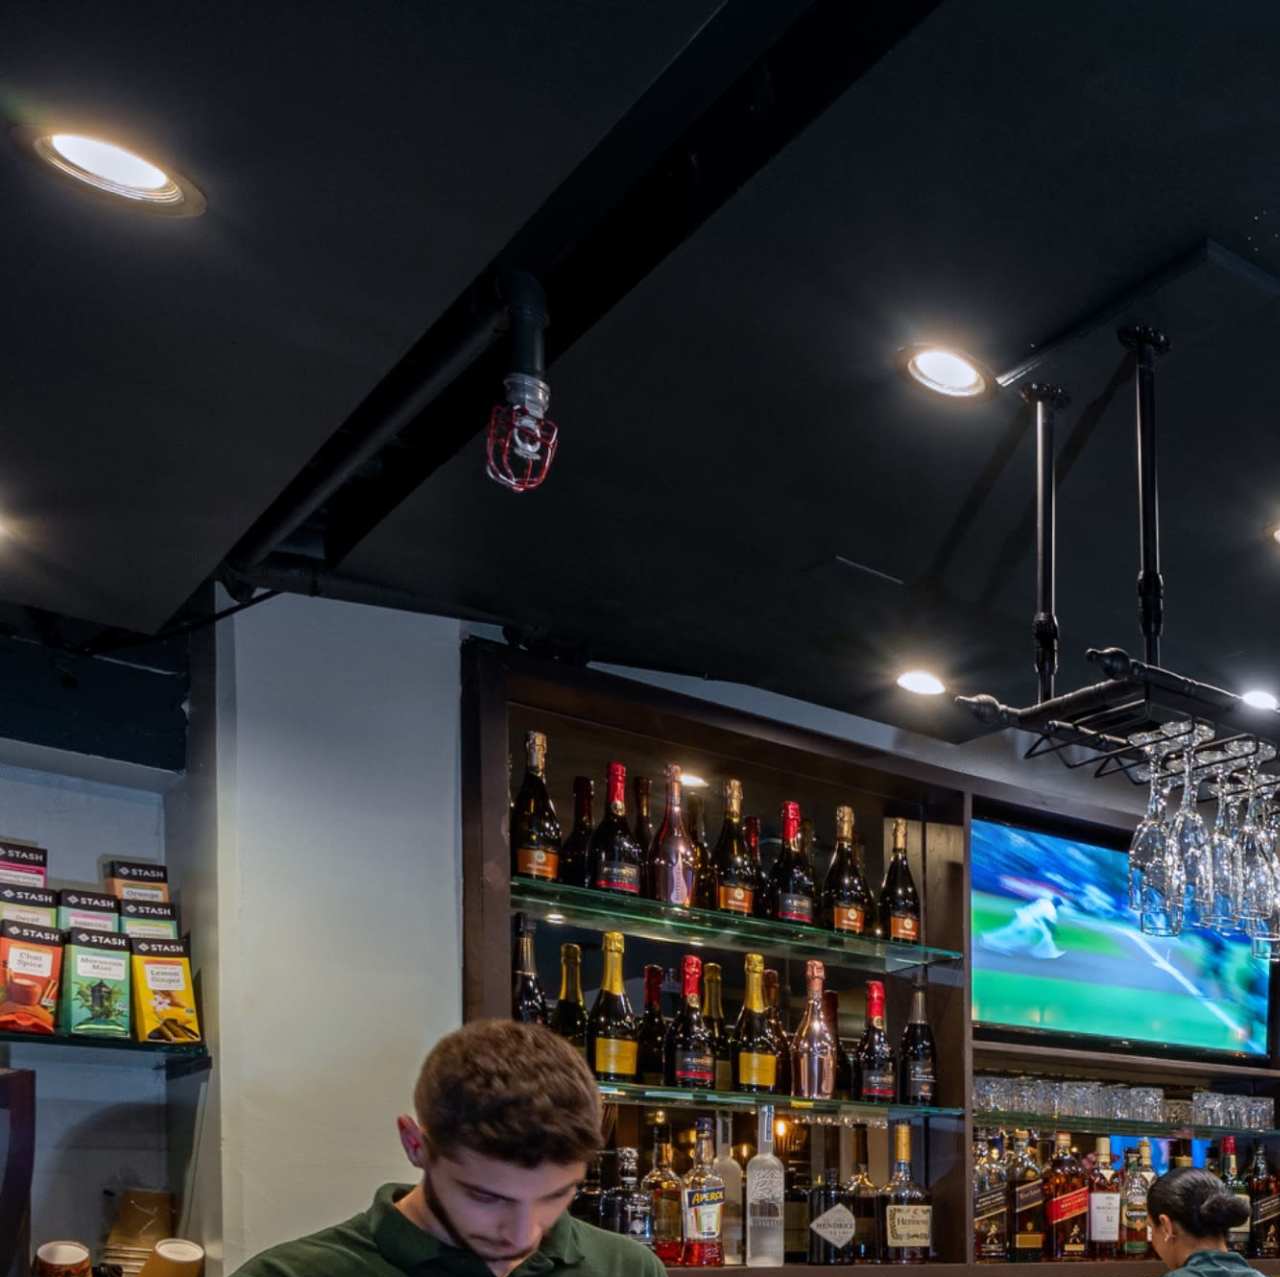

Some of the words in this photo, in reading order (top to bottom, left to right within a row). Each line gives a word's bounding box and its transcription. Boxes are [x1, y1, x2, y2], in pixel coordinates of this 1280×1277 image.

[7, 849, 43, 862] STASH
[131, 868, 164, 878] STASH
[16, 891, 52, 903] STASH
[80, 897, 115, 908] STASH
[138, 906, 171, 916] STASH
[22, 929, 60, 941] STASH
[91, 935, 126, 946] STASH
[151, 944, 184, 952] STASH
